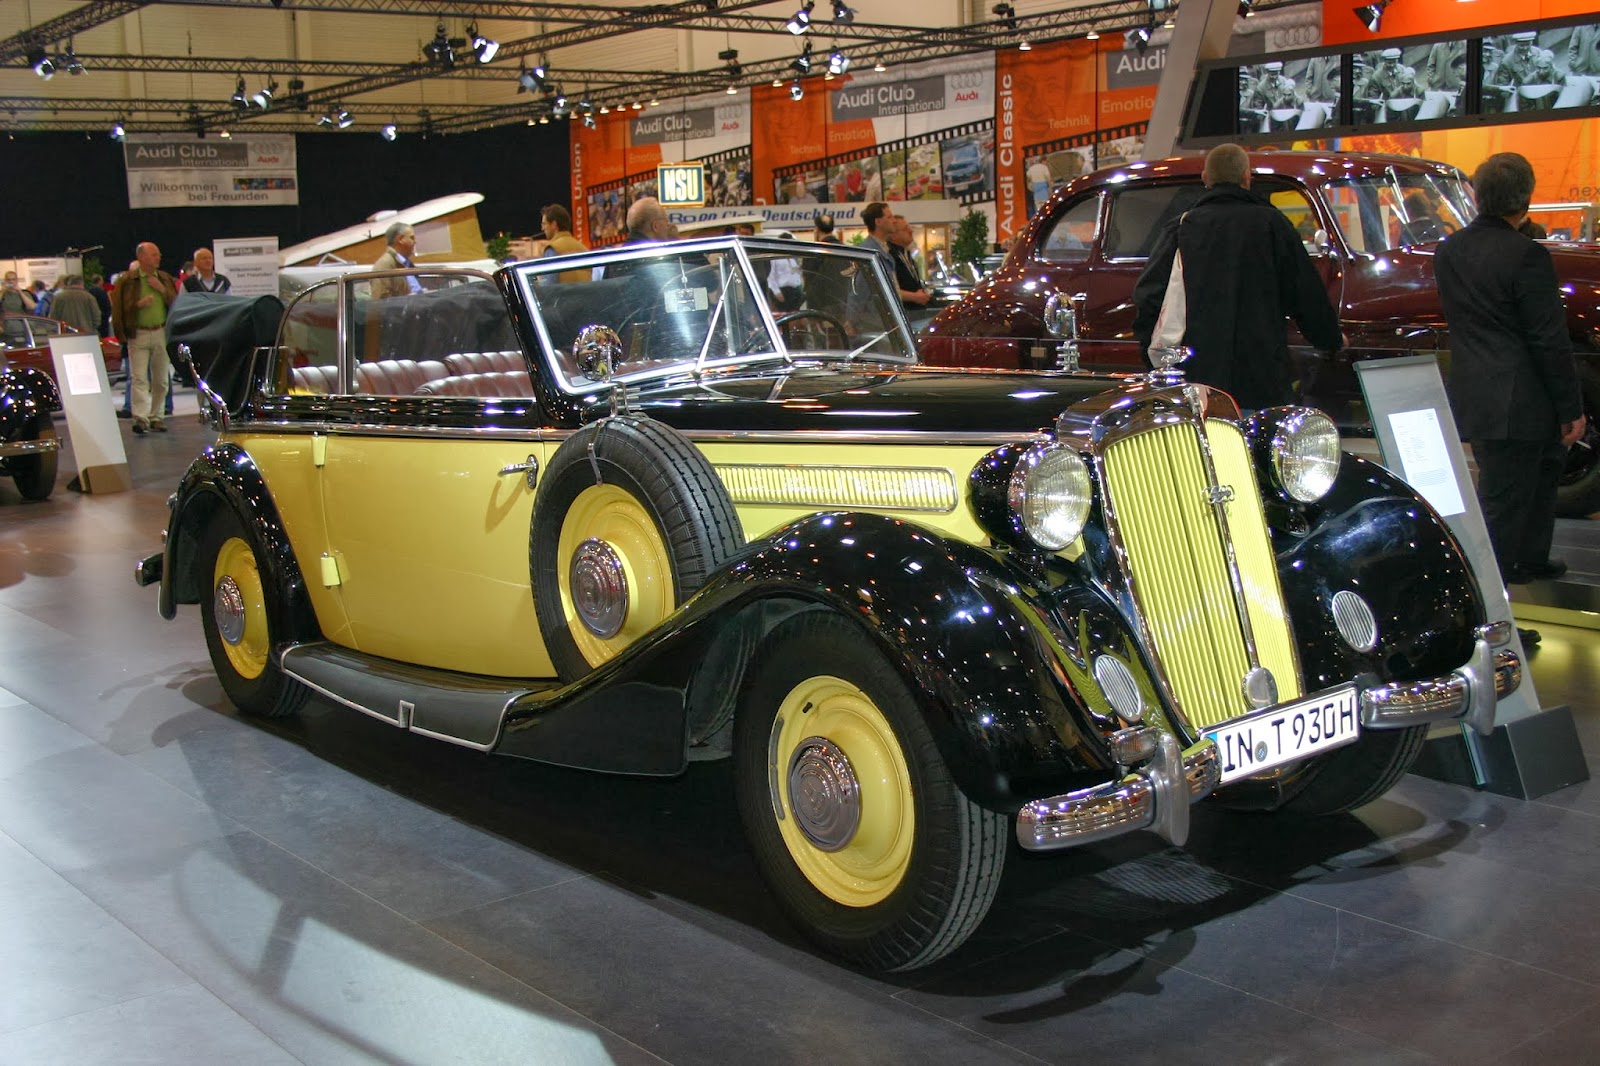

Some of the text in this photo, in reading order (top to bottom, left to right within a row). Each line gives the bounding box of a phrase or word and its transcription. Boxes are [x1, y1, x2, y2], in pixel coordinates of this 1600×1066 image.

[1116, 49, 1166, 74] Audi
[837, 84, 915, 109] Audi Club
[955, 91, 979, 102] Audi
[878, 97, 944, 116] International
[1101, 96, 1155, 113] Emotio
[635, 115, 692, 136] Audi Club
[722, 121, 739, 131] Audi
[1048, 115, 1090, 129] Technik
[665, 127, 714, 141] International
[829, 128, 874, 142] Emotion
[136, 144, 217, 158] Audi Club
[1000, 74, 1013, 235] Audi Classic
[181, 158, 248, 167] International
[257, 155, 280, 164] Audi
[573, 143, 582, 200] Union
[140, 182, 218, 192] Willkommen
[664, 168, 699, 201] NSU
[189, 191, 268, 201] bei Freunden
[762, 207, 855, 222] Deutschland
[1224, 697, 1353, 772] IN T 930H
